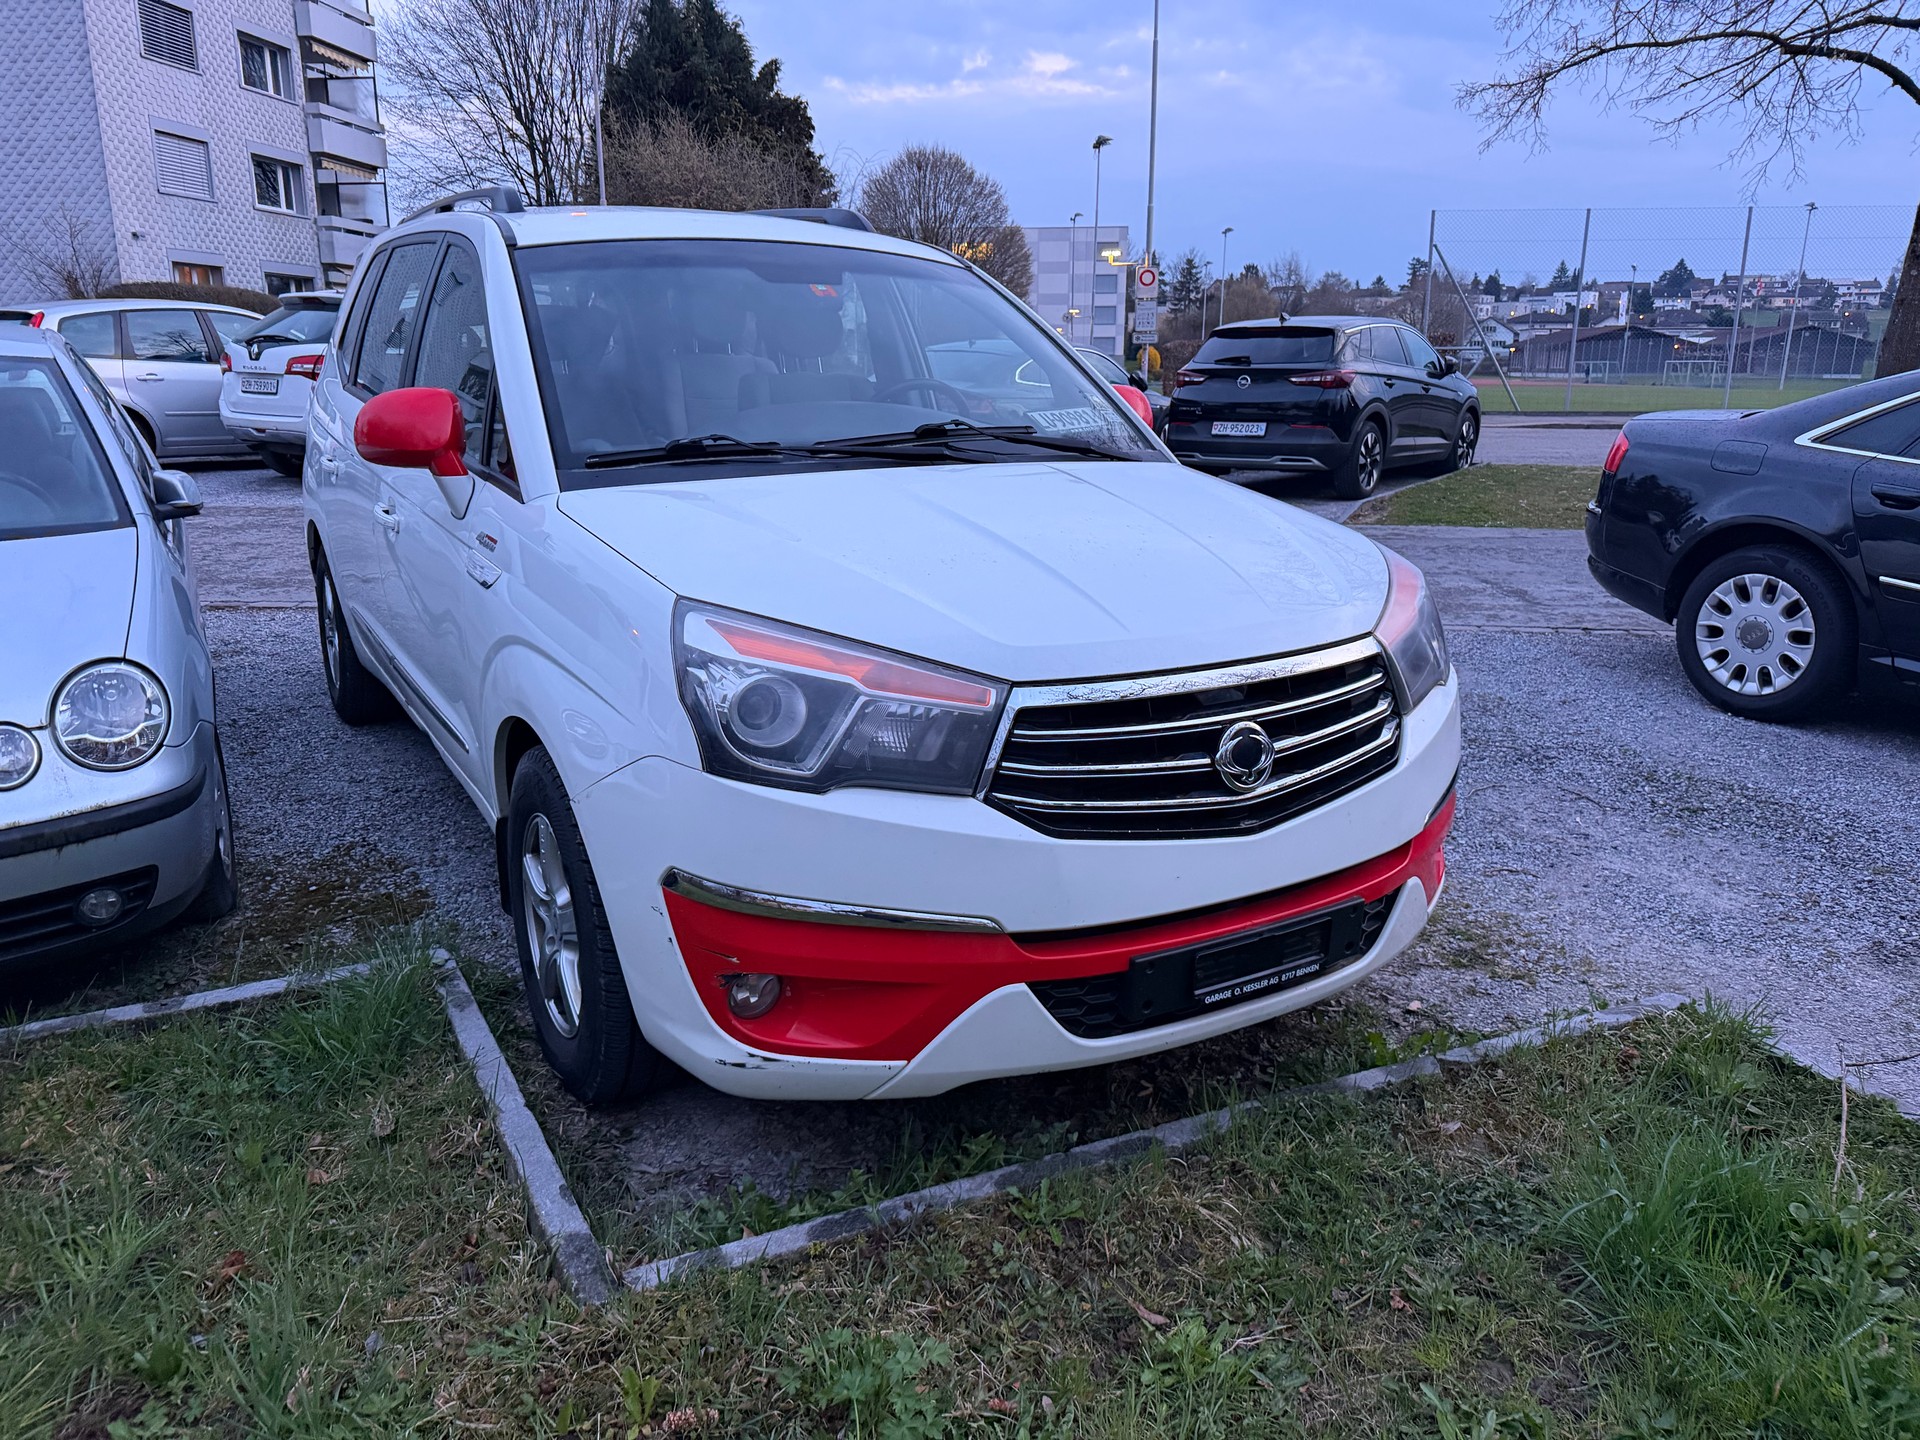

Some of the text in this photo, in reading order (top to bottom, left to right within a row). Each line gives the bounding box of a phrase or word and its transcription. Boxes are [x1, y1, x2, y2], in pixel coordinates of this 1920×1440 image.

[1204, 963, 1319, 1004] GARAGE O. KESSLER AG 8717 BENKEN
